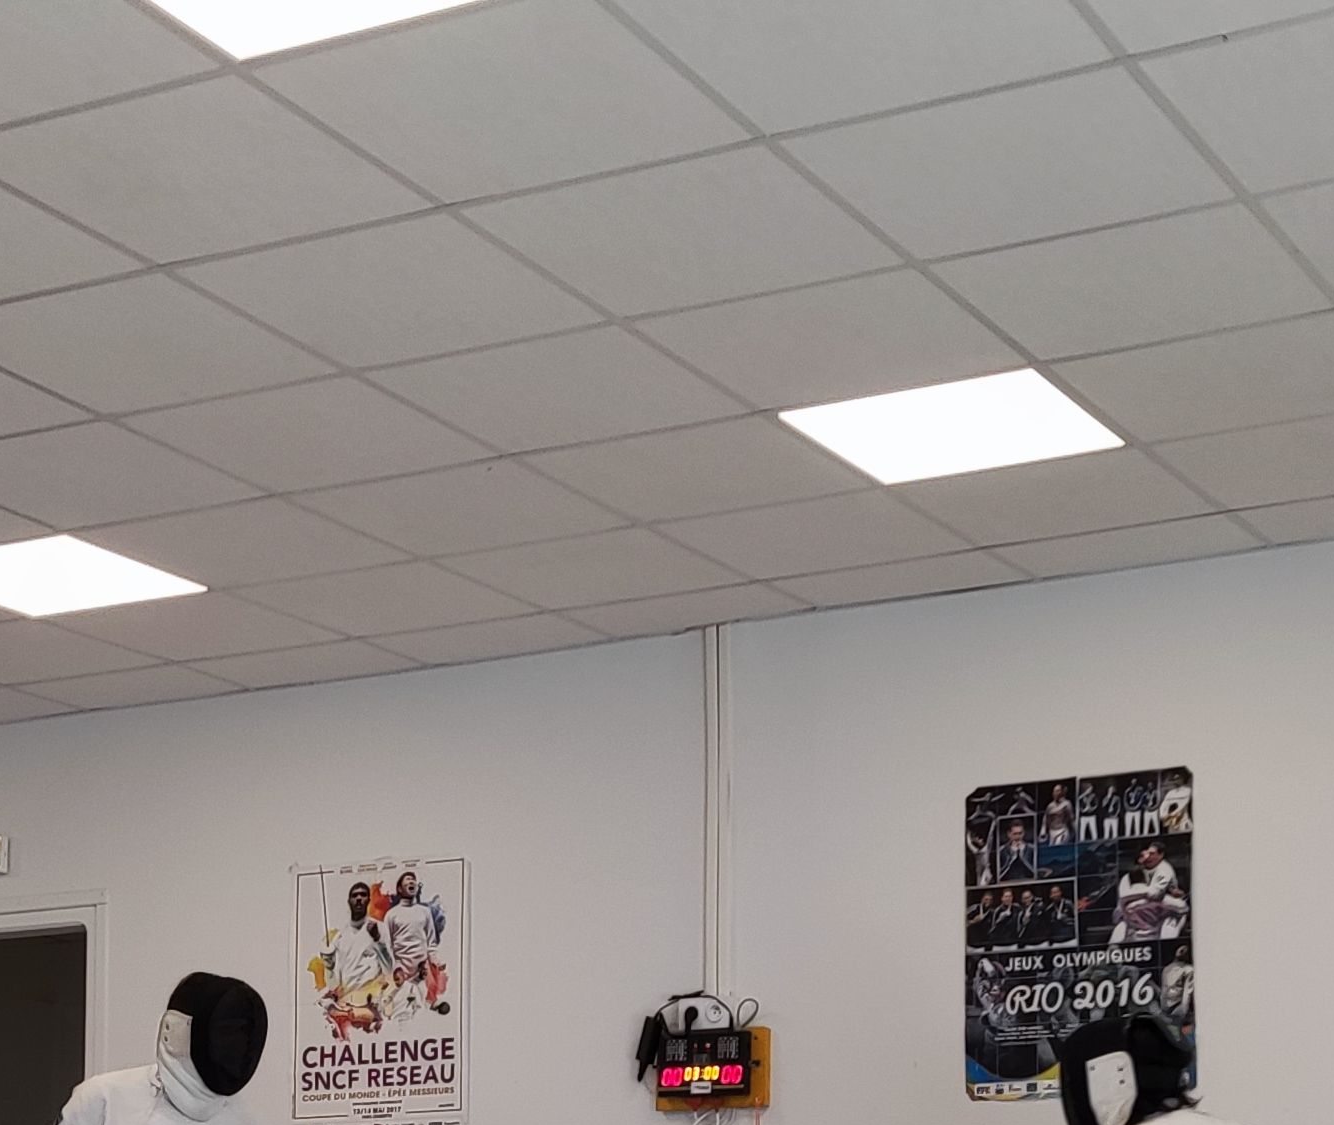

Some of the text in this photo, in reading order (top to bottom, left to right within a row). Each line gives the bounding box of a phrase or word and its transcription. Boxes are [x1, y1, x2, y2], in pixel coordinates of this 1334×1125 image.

[1005, 947, 1152, 972] JEUX OLYMPIQUES
[1005, 972, 1154, 1016] RIO 2016
[302, 1037, 455, 1069] CHALLENGE
[301, 1063, 455, 1091] SNCF RESEAU
[661, 1067, 683, 1087] 00
[721, 1065, 743, 1084] 00
[302, 1093, 332, 1102] COUPE
[334, 1093, 346, 1101] DU
[349, 1090, 380, 1099] MONDE
[388, 1087, 407, 1098] ÉPÉE
[409, 1086, 455, 1097] MESSIEURS
